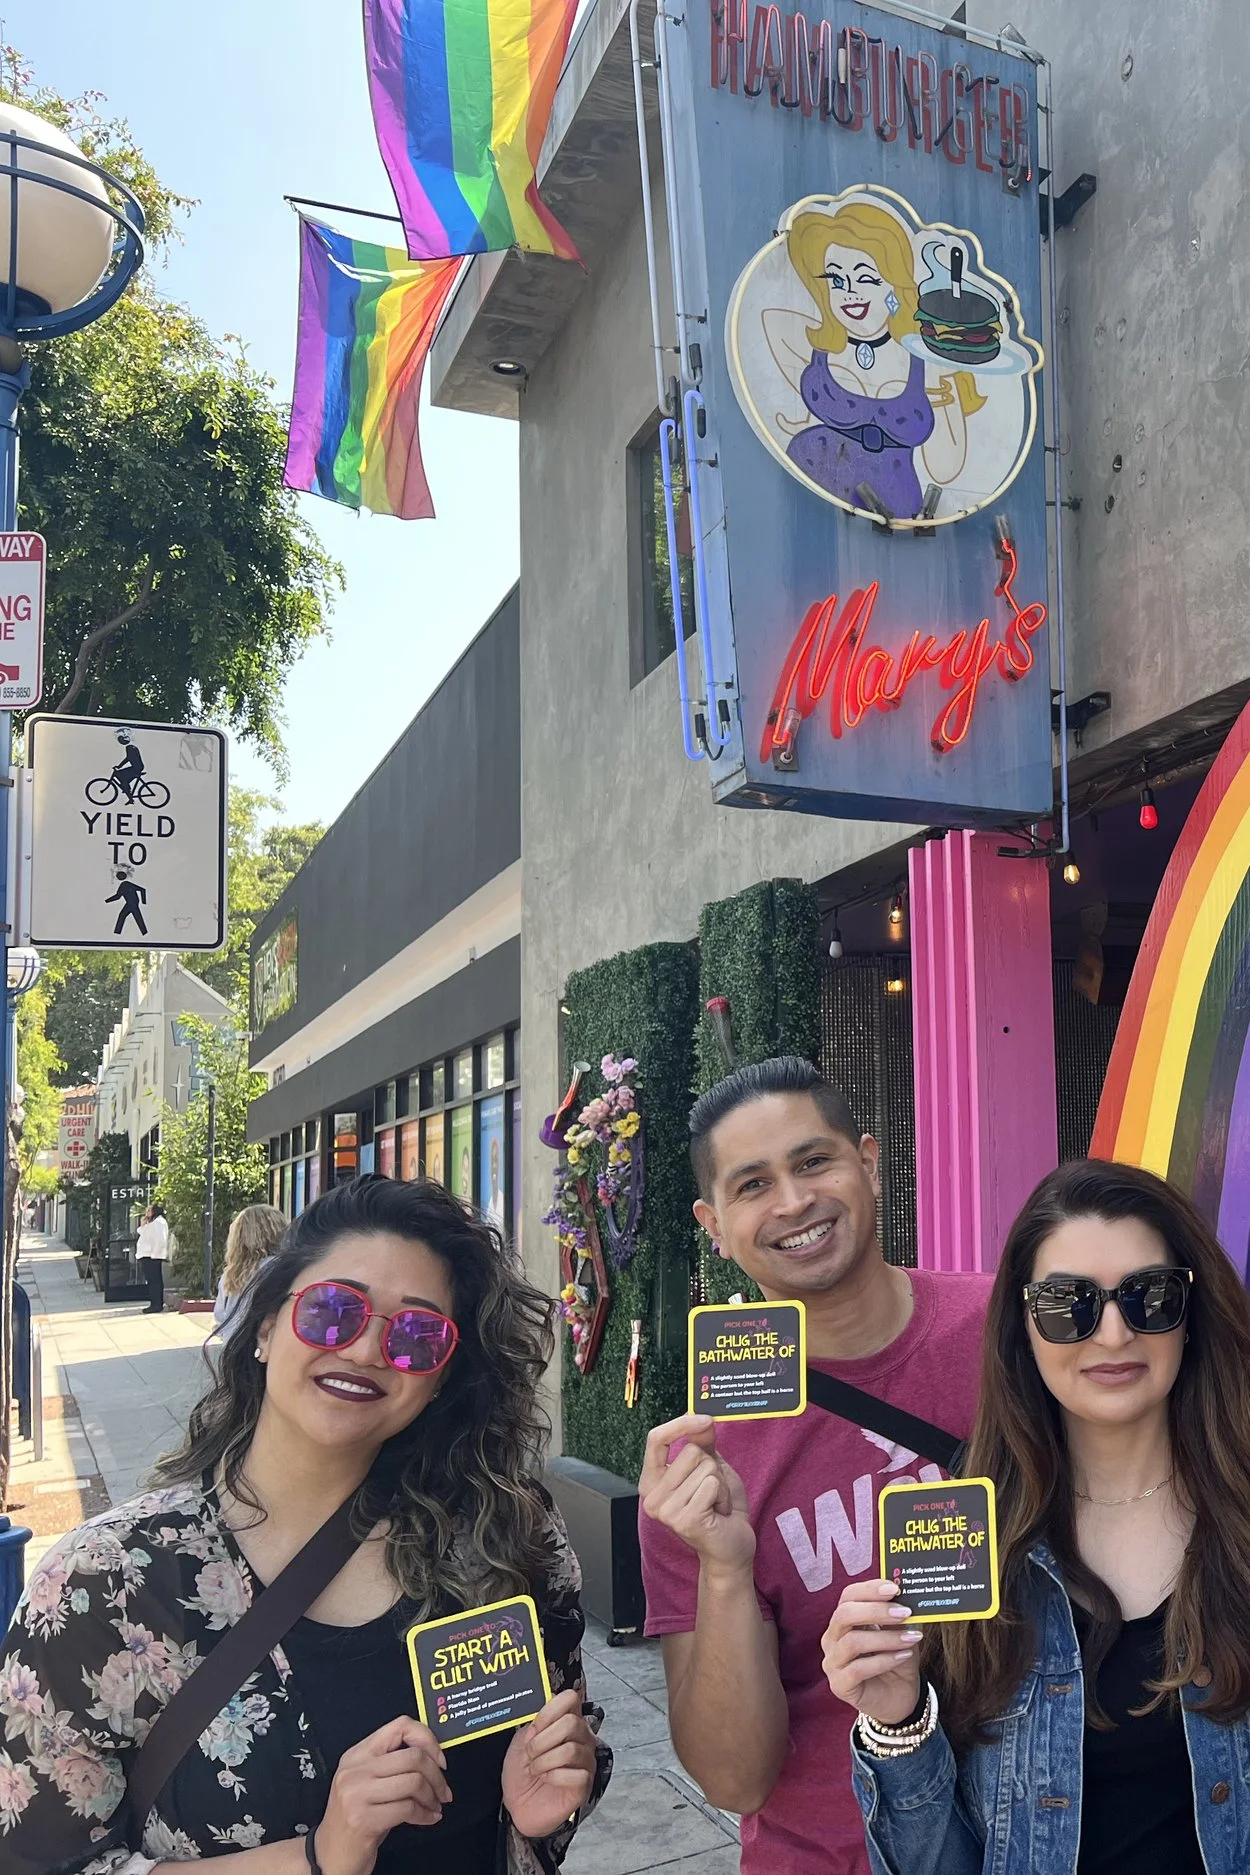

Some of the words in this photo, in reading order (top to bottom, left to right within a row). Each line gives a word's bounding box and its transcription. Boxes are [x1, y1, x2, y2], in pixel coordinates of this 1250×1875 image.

[710, 0, 1032, 177] HAMBURGER
[760, 550, 1047, 764] Mary's
[80, 811, 176, 838] YIELD
[107, 841, 147, 866] TO
[61, 1117, 92, 1127] URGENT
[67, 1128, 86, 1137] CARE
[716, 1334, 749, 1347] CHUG
[754, 1332, 778, 1345] THE
[698, 1346, 774, 1363] BATHWATER
[778, 1344, 795, 1357] OF
[912, 1502, 929, 1511] PICK
[930, 1501, 944, 1509] ONE
[905, 1518, 939, 1535] CHUG
[942, 1515, 967, 1532] THE
[889, 1532, 964, 1553] BATHWATER
[967, 1531, 985, 1547] OF
[449, 1632, 467, 1642] PICK
[434, 1634, 493, 1667] START
[500, 1629, 513, 1649] A
[430, 1661, 474, 1690] CULT
[479, 1645, 530, 1675] WITH
